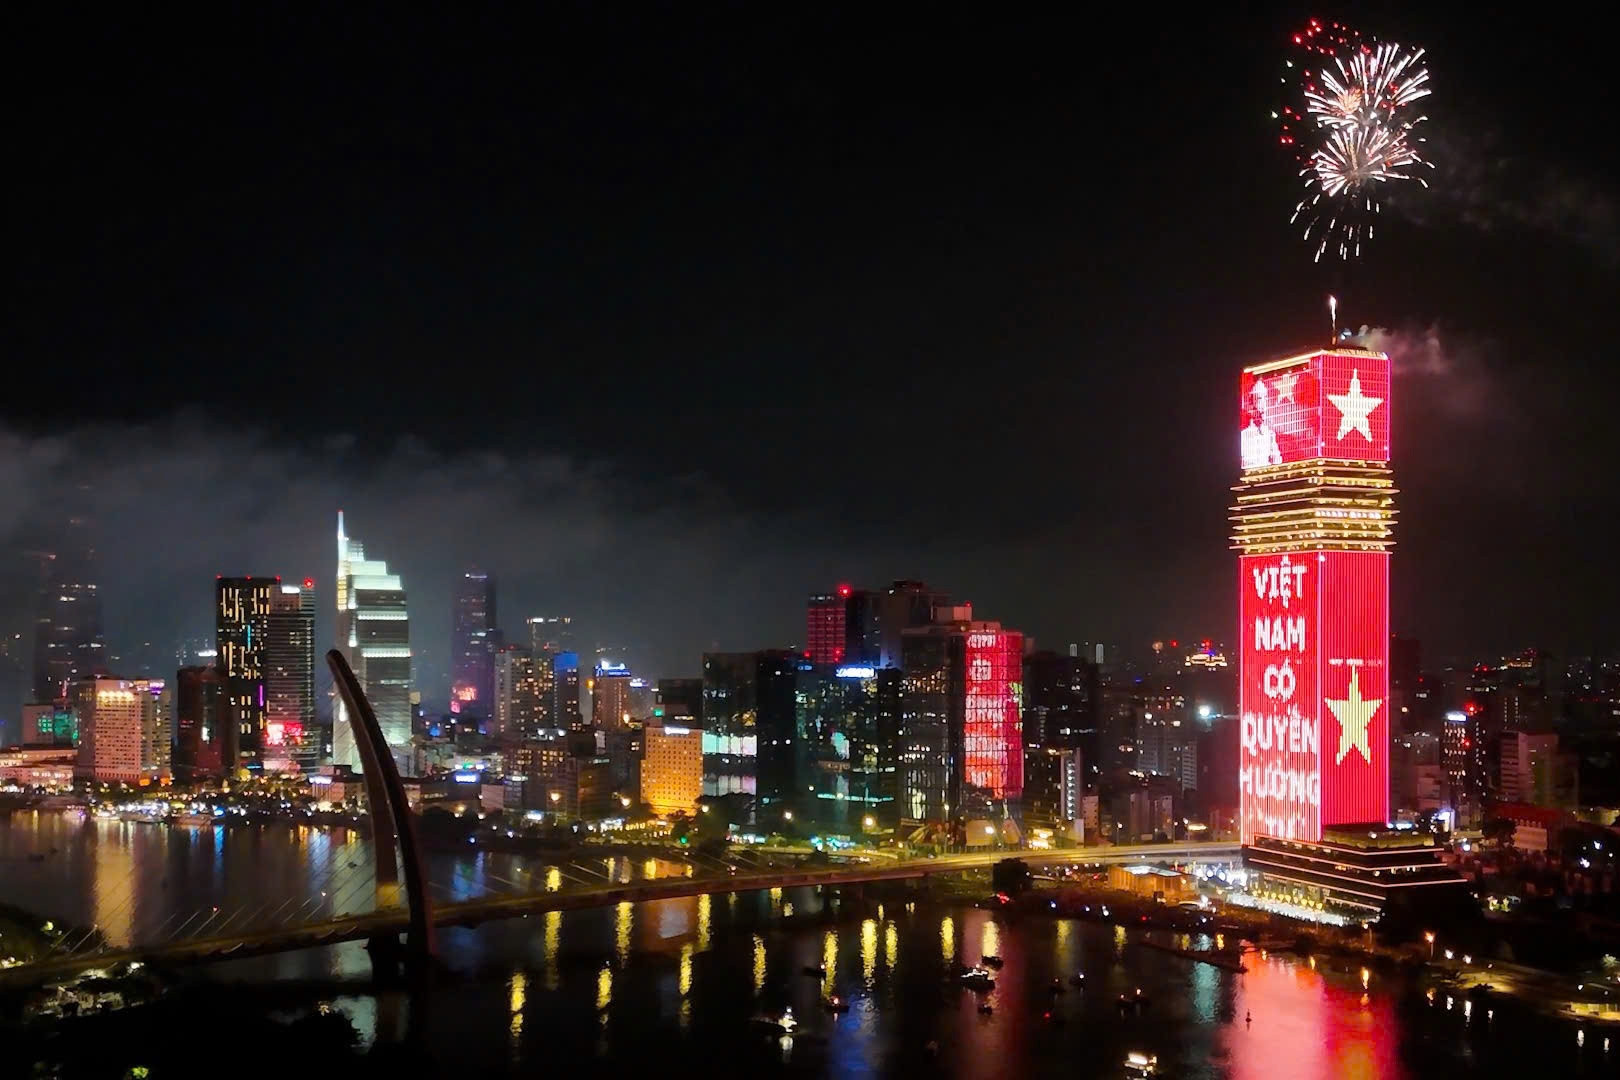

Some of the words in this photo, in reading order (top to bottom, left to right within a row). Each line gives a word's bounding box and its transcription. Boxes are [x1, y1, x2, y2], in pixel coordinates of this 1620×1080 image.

[1253, 554, 1307, 608] VIỆT
[1255, 615, 1305, 653] NAM
[1264, 657, 1296, 702] CÓ
[1242, 704, 1318, 757] QUYỀN
